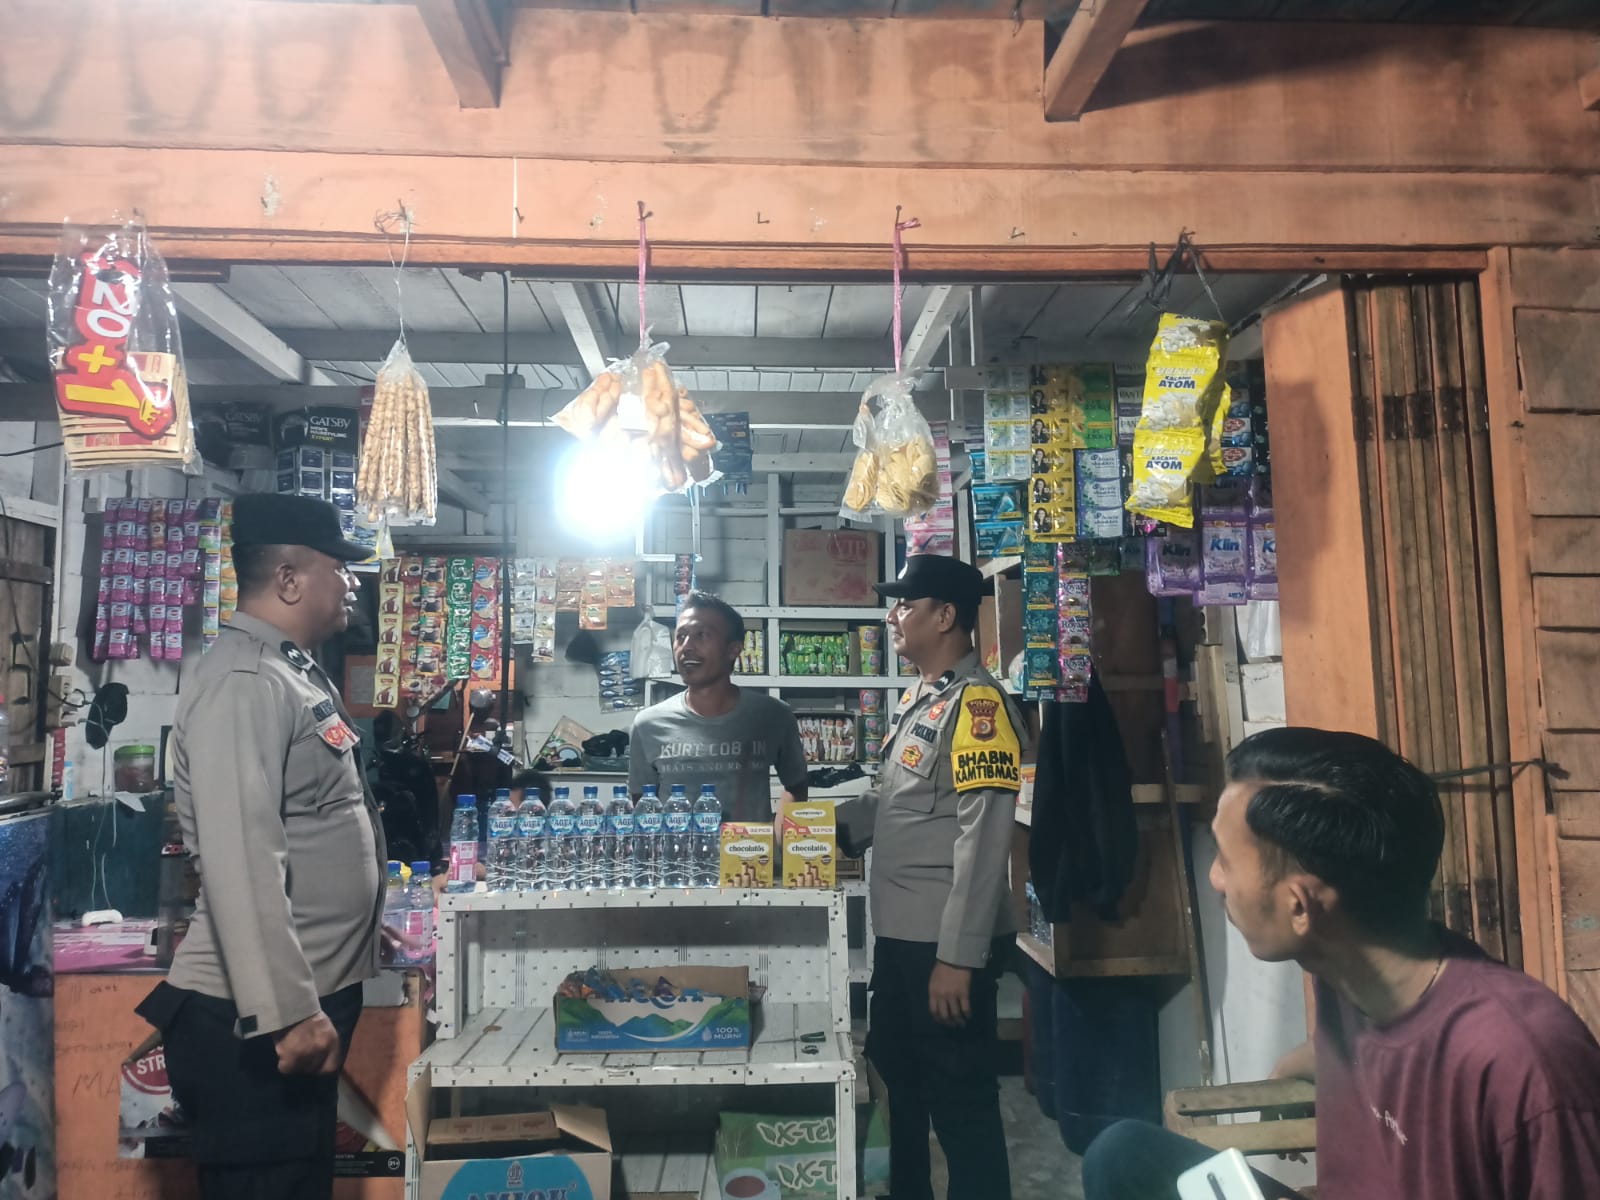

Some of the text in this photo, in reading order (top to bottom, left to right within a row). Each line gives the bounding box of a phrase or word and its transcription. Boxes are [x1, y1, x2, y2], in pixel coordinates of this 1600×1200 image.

[1159, 380, 1195, 389] ATOM
[310, 415, 350, 429] GATSBY
[1146, 460, 1182, 470] ATOM
[1210, 538, 1240, 551] Klin
[957, 750, 1014, 768] BHABIN
[955, 764, 1019, 784] KAMTIBMAS
[554, 819, 572, 828] AQUA
[581, 818, 599, 827] AQUA
